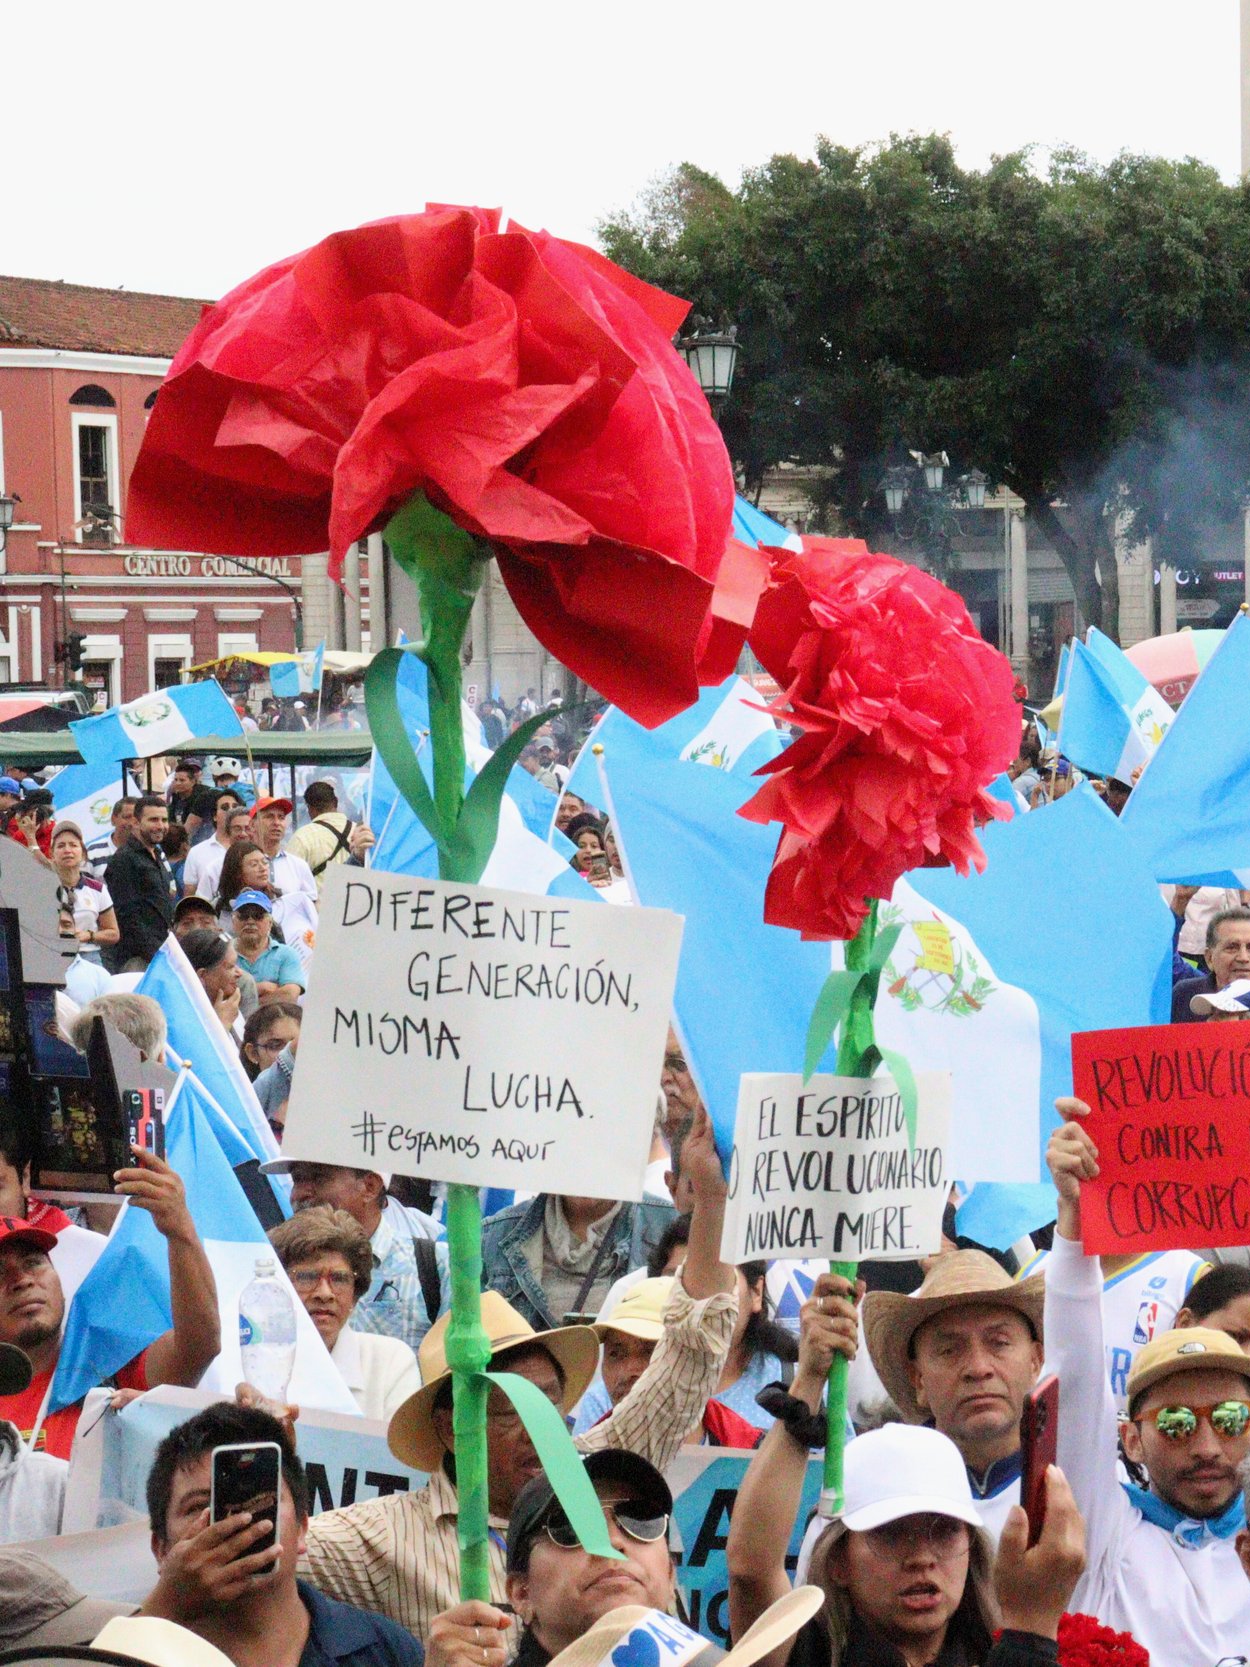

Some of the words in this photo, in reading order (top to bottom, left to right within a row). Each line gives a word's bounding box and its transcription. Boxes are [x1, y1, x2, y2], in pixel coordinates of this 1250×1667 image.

[125, 555, 191, 576] CENTRO
[201, 555, 291, 577] COMERCIAL
[342, 882, 571, 949] DIFERENTE
[407, 951, 640, 1013] GENERACIÓN,
[333, 1006, 461, 1060] MISMA
[463, 1065, 594, 1120] LUCHA.
[758, 1097, 781, 1141] EL
[796, 1090, 905, 1140] ESPÍRITU
[129, 1126, 137, 1165] SOY
[1117, 1121, 1224, 1165] CONTRA
[744, 1205, 823, 1256] NUNCA
[833, 1205, 920, 1254] MUERE.
